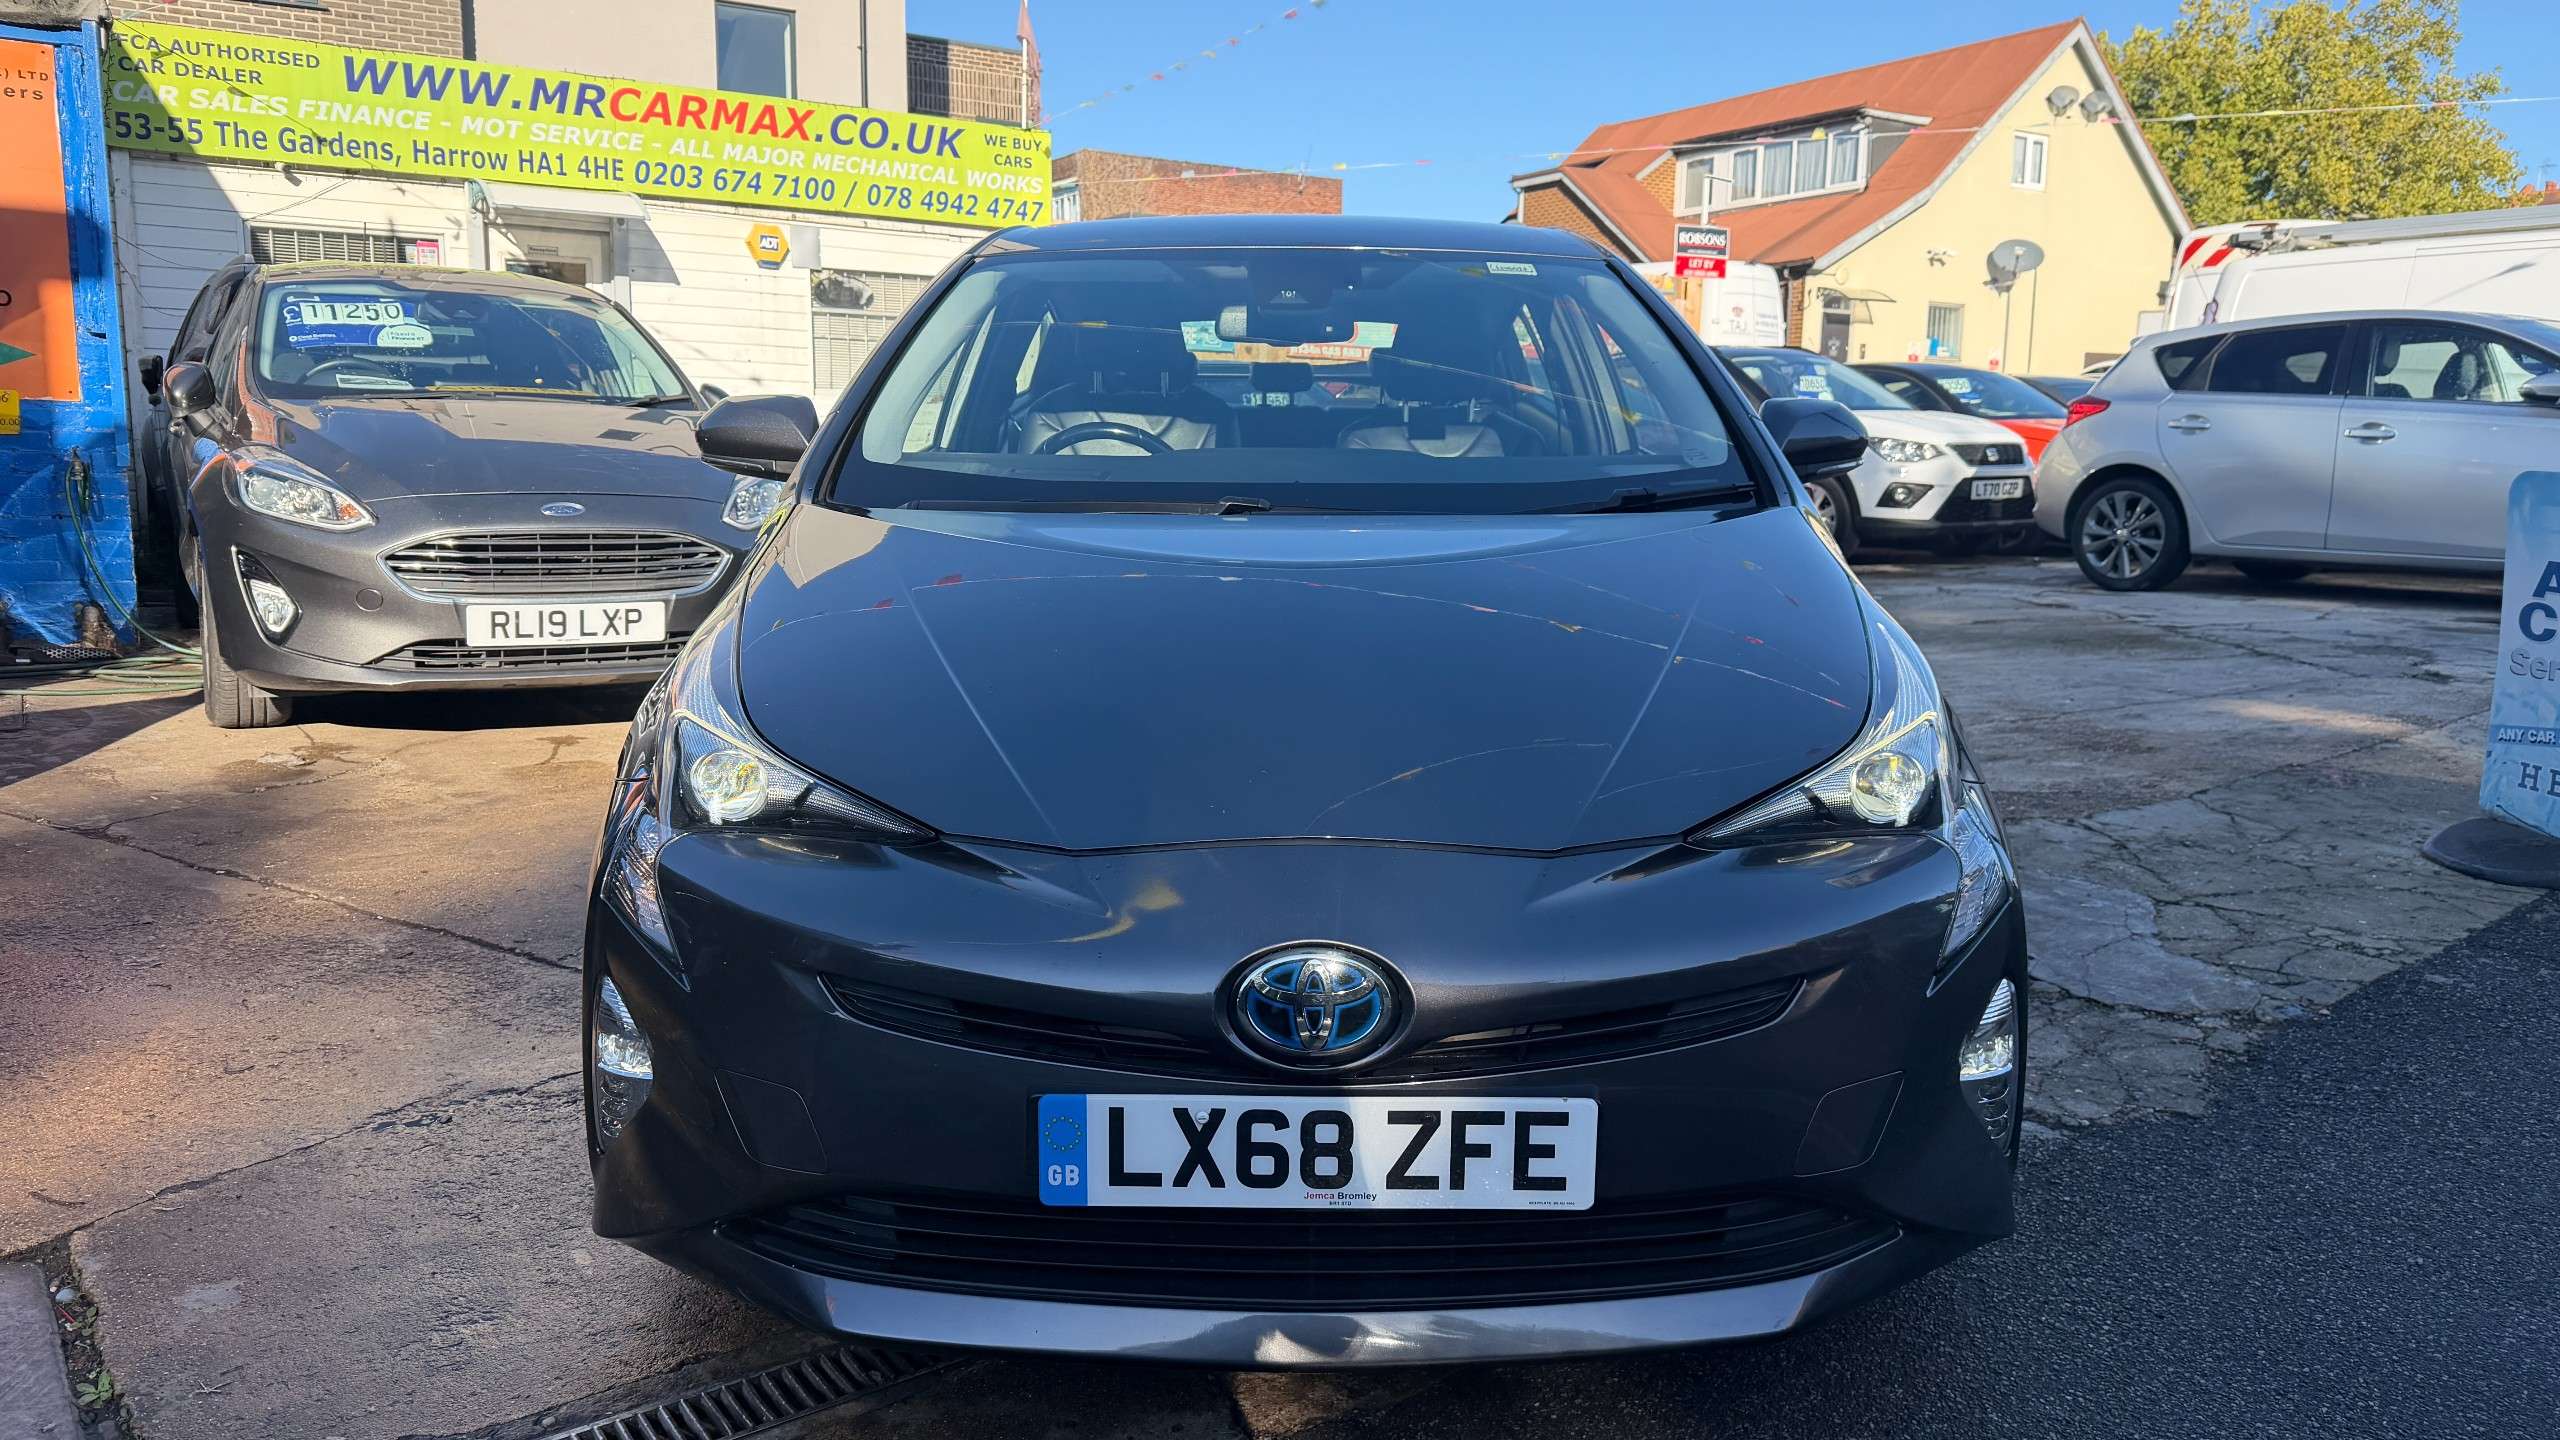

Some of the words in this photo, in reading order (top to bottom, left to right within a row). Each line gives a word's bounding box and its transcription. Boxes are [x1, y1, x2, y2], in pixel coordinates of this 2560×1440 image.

[116, 33, 162, 52] FCA
[170, 39, 320, 69] AUTHORISED
[18, 69, 49, 81] LTD
[118, 56, 166, 75] CAR
[174, 62, 264, 85] DEALER
[343, 56, 966, 159] WWW.MRCARMAX.CO.UK
[113, 81, 179, 107] CAR
[189, 87, 289, 117] SALES
[297, 99, 432, 131] FINANCE
[461, 116, 524, 140] MOT
[529, 123, 645, 151] SERVICE
[669, 138, 715, 159] ALL
[723, 143, 805, 169] MAJOR
[812, 153, 960, 185] MECHANICAL
[966, 169, 1045, 195] WORKS
[984, 133, 1008, 148] WE
[1012, 137, 1043, 152] BUY
[114, 111, 204, 145] 53-55
[213, 120, 268, 151] The
[277, 126, 402, 168] Gardens,
[412, 139, 509, 171] Harrow
[518, 149, 568, 177] HA1
[577, 155, 625, 182] 4HE
[634, 159, 704, 189] 0203
[713, 168, 763, 195] 674
[772, 173, 836, 202] 7100
[867, 183, 913, 210] 078
[920, 189, 979, 216] 4942
[986, 197, 1045, 223] 4747
[993, 153, 1033, 169] CARS
[490, 610, 568, 639] RL19
[579, 608, 642, 637] LXP
[2498, 727, 2525, 743] ANY
[2527, 729, 2557, 745] CAR
[1108, 1106, 1354, 1190] LX68
[1386, 1110, 1570, 1192] ZFE
[1047, 1164, 1080, 1187] GB
[1304, 1191, 1335, 1200] Jemca
[1337, 1191, 1377, 1202] Bromley
